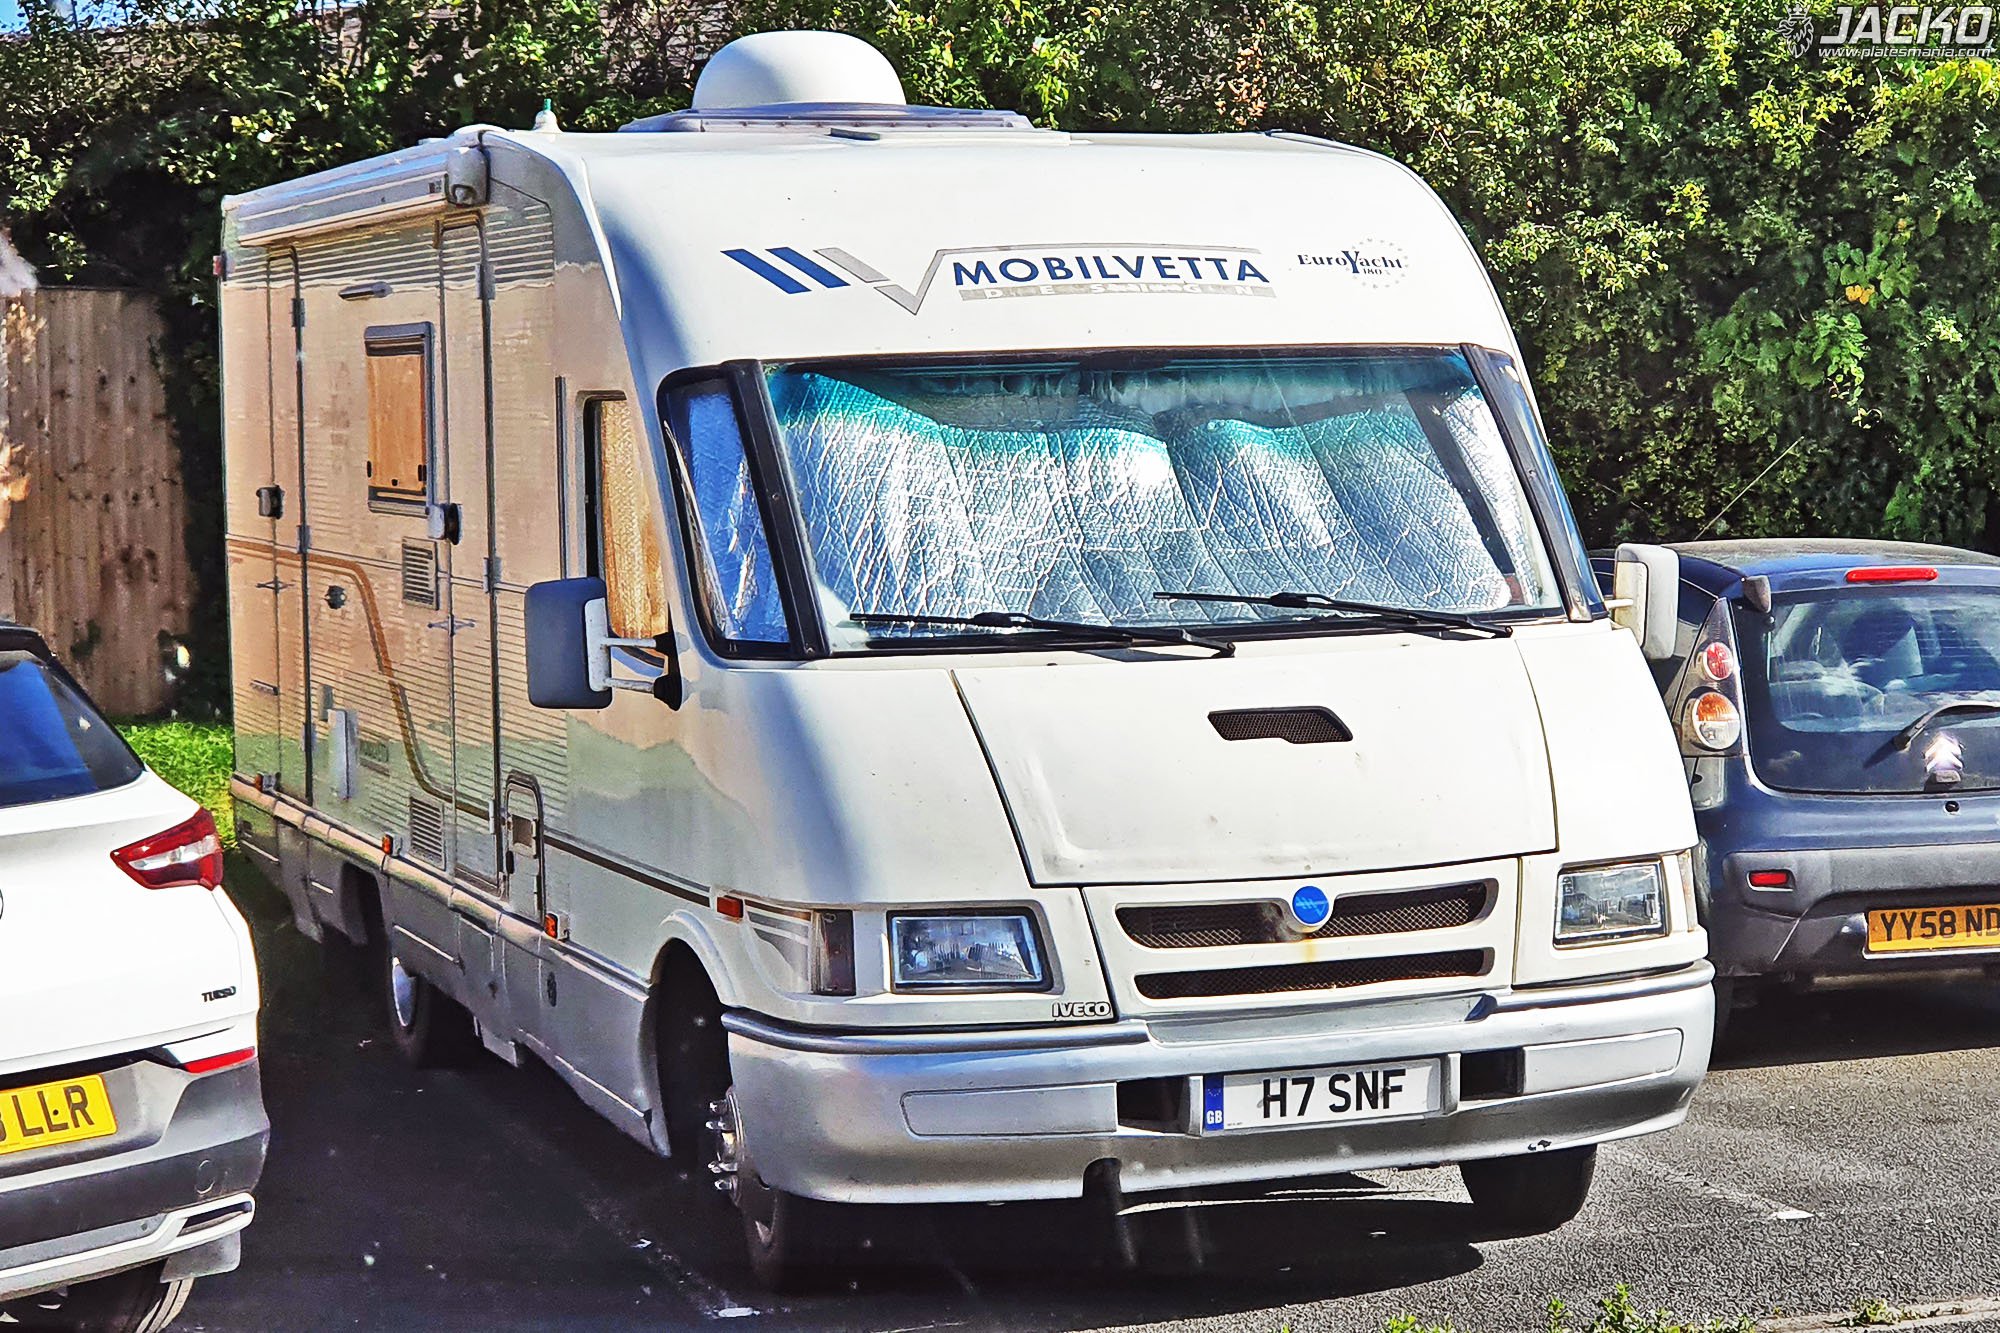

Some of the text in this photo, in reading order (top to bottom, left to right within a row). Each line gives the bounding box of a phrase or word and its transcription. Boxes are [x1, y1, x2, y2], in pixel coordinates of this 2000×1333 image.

[952, 255, 1270, 287] MOBILVETTA
[1880, 909, 1957, 942] YY58
[1051, 1001, 1112, 1018] IVECO
[1262, 1068, 1407, 1119] H7 SNF
[1206, 1110, 1223, 1125] GB
